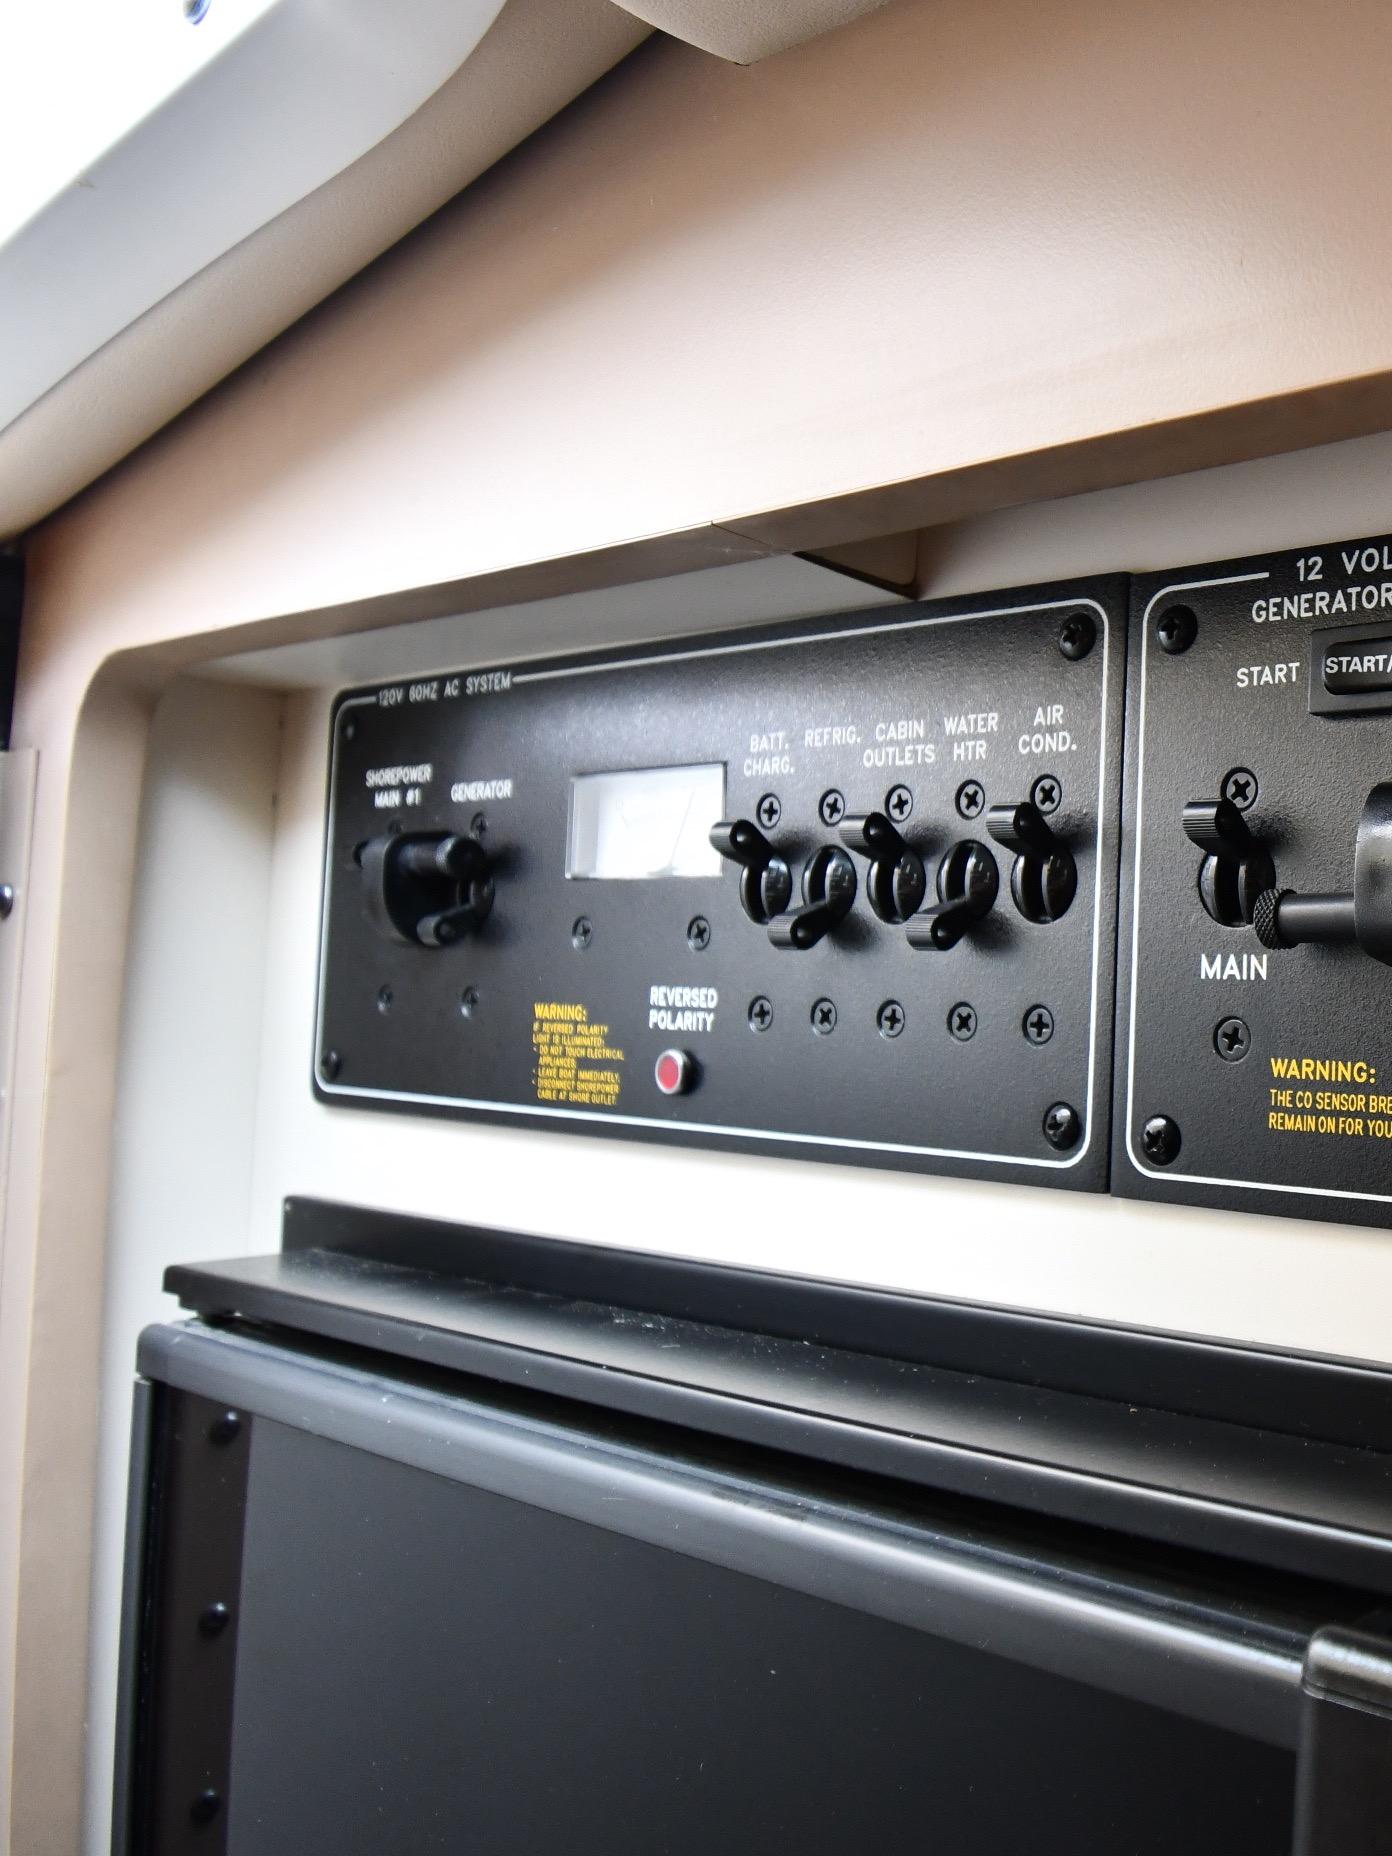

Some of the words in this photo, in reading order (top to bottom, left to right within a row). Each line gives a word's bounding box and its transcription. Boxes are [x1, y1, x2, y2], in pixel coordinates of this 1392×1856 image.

[1296, 556, 1324, 582] 12
[1236, 662, 1300, 687] START
[378, 688, 405, 707] 120V
[443, 680, 460, 697] AC
[465, 672, 512, 696] SYSTEM
[943, 713, 998, 736] WATER
[1033, 705, 1064, 726] AIR
[804, 726, 861, 747] REFRIG.
[875, 720, 924, 741] CABIN
[750, 732, 789, 752] BATT.
[953, 740, 987, 761] HTR
[1018, 733, 1077, 754] COND.
[744, 757, 795, 776] CHARG.
[863, 745, 936, 768] OUTLETS
[365, 764, 433, 788] SHOREPOWER
[374, 791, 400, 808] MAIN
[405, 788, 422, 806] #1
[451, 779, 513, 802] GENERATOR
[1200, 953, 1268, 981] MAIN
[649, 985, 718, 1009] REVERSED
[533, 1002, 587, 1022] WARNING:
[649, 1009, 715, 1032] POLARITY
[542, 1023, 573, 1034] REVERSED
[577, 1025, 608, 1035] POLARITY
[540, 1046, 548, 1055] DO
[550, 1046, 562, 1055] NOT
[565, 1047, 584, 1057] TOUCH
[587, 1049, 624, 1060] ELECTRICAL
[538, 1068, 556, 1077] LEAVE
[559, 1069, 575, 1078] BOAT
[1270, 1057, 1377, 1084] WARNING:
[538, 1079, 574, 1090] DISCONNECT
[1269, 1088, 1293, 1107] THE
[1295, 1091, 1312, 1109] CO
[1315, 1092, 1366, 1112] SENSOR
[1268, 1112, 1316, 1132] REMAIN
[1318, 1115, 1336, 1133] ON
[1339, 1117, 1365, 1135] FOR
